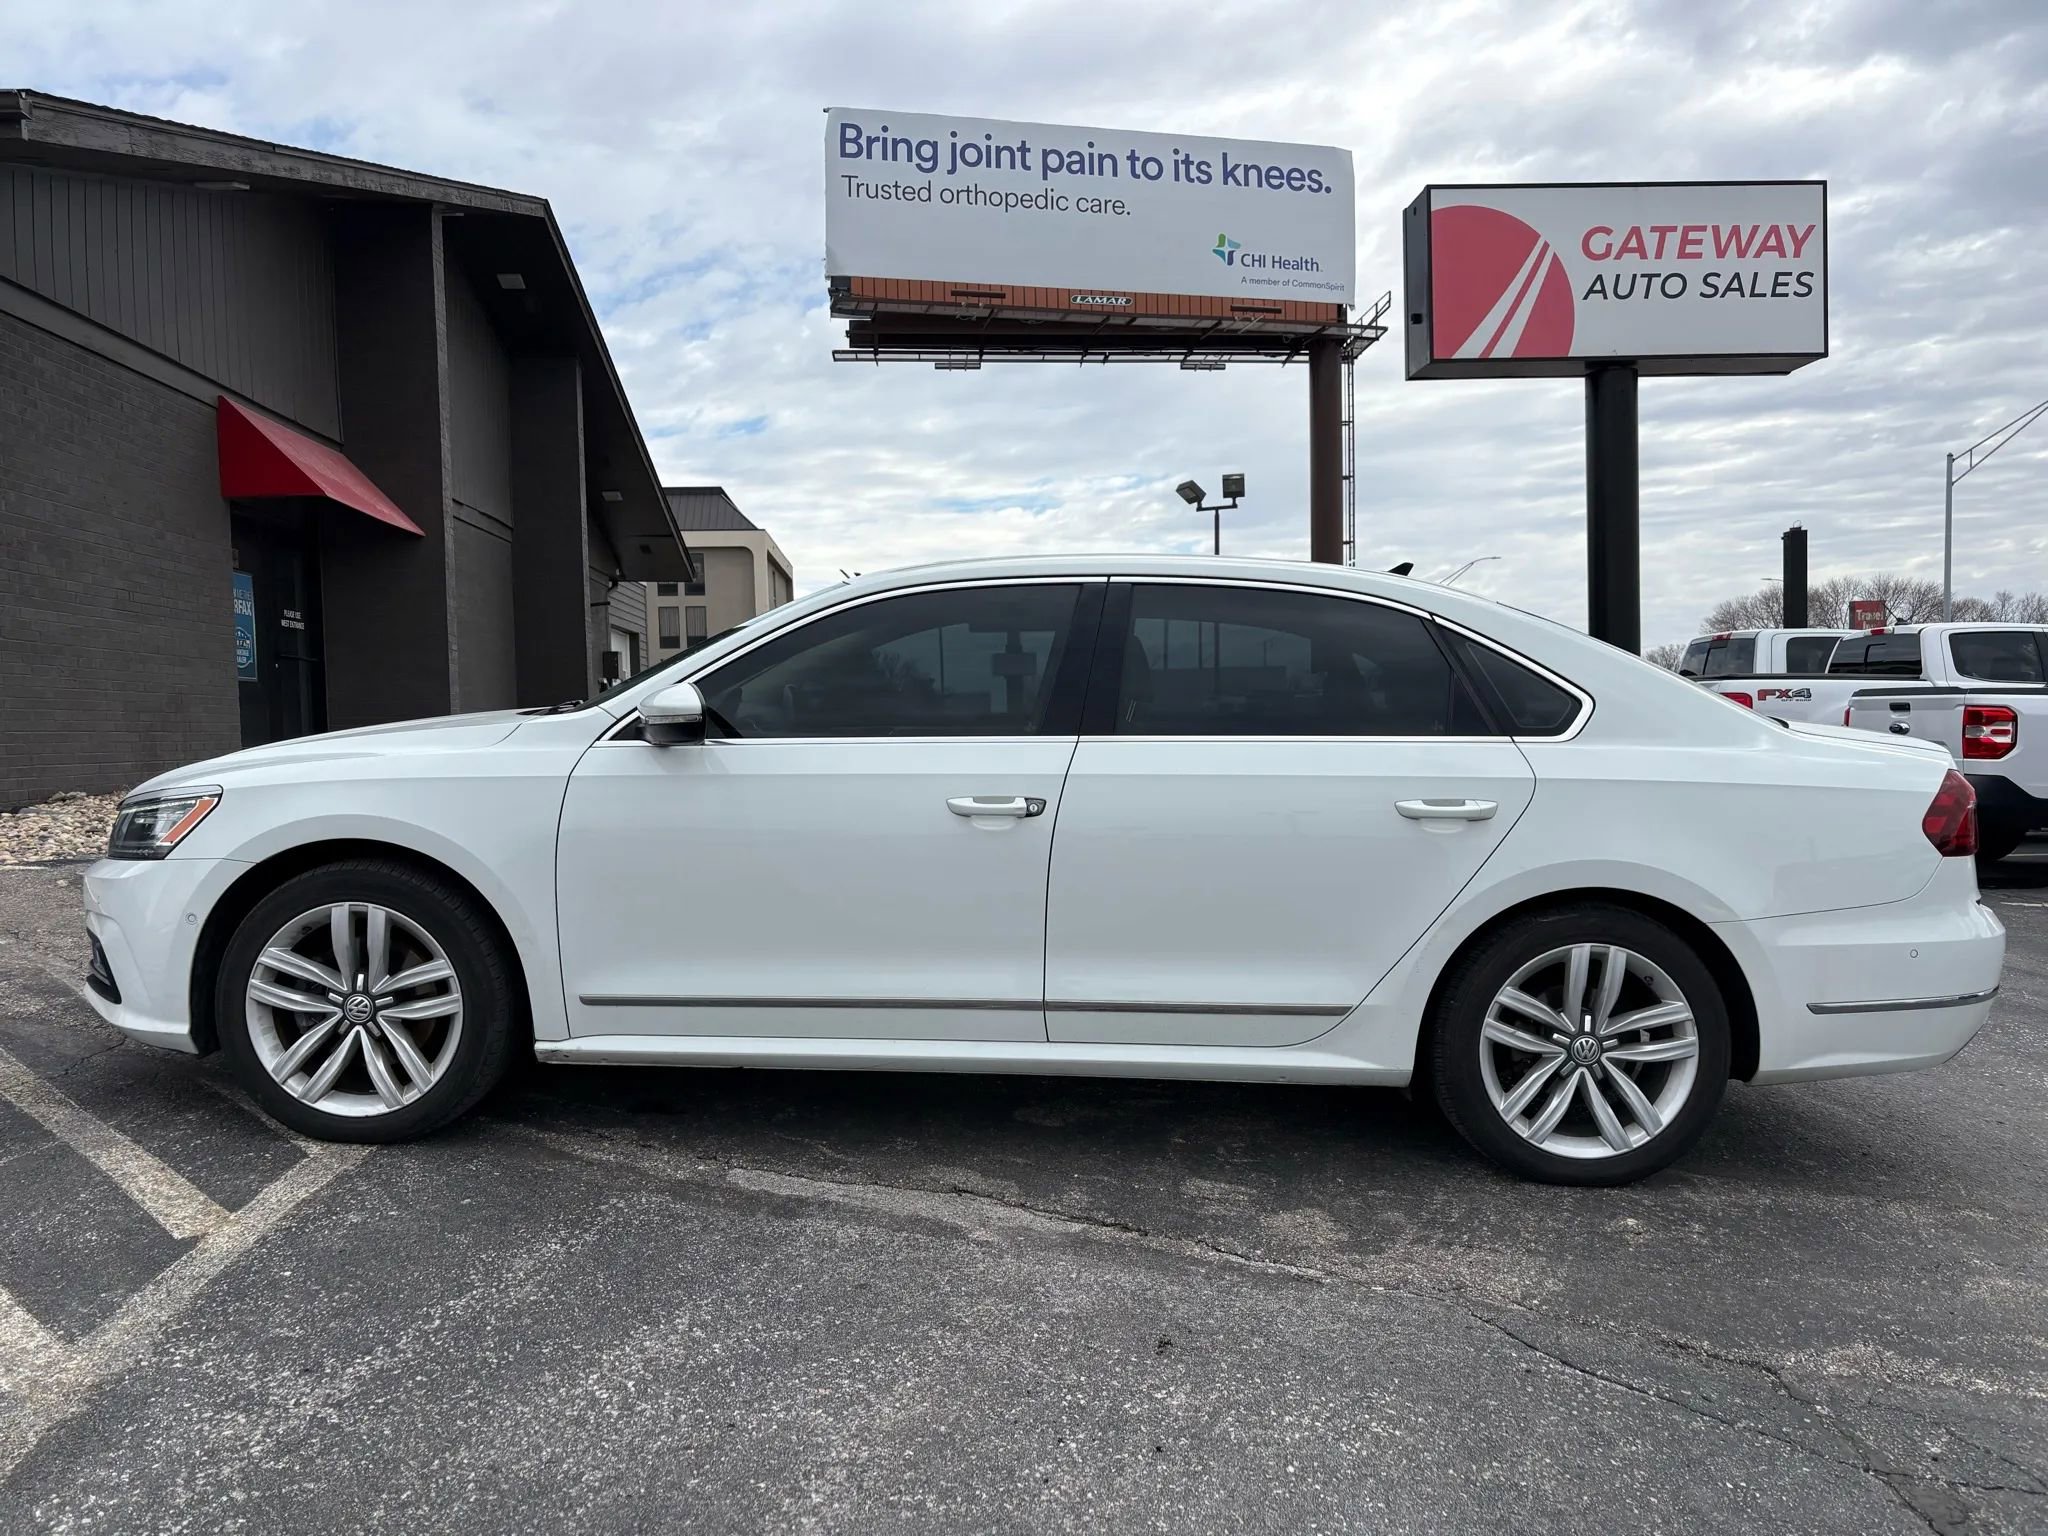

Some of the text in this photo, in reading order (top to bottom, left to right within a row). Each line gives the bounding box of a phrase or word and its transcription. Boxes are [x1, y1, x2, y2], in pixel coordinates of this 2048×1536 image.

[839, 122, 1332, 194] Bring joint pain to its knees.
[841, 174, 1131, 216] Trusted orthopedic care.
[1581, 224, 1817, 261] GATEWAY
[1240, 253, 1319, 272] CHI Health
[1241, 276, 1345, 292] A member of CommonSpirit
[1582, 271, 1815, 300] AUTO SALES
[1076, 296, 1126, 305] LAMAR
[1855, 609, 1885, 621] Travel
[1757, 688, 1812, 701] FX4
